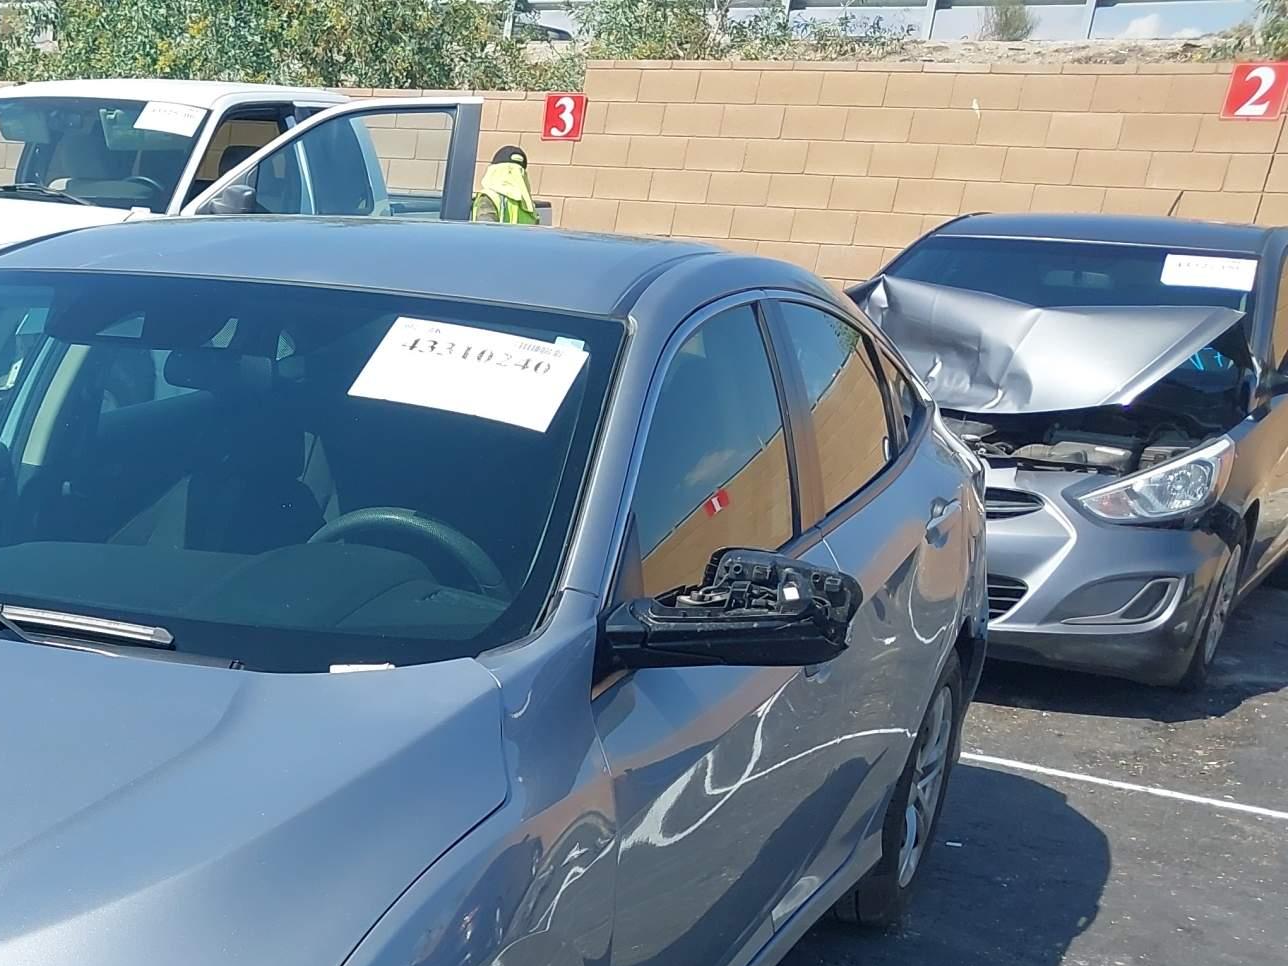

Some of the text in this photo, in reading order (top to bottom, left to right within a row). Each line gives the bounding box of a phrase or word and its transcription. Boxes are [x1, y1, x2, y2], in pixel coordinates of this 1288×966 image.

[1233, 66, 1276, 116] 2
[550, 96, 575, 137] 3
[401, 337, 552, 375] 43310240
